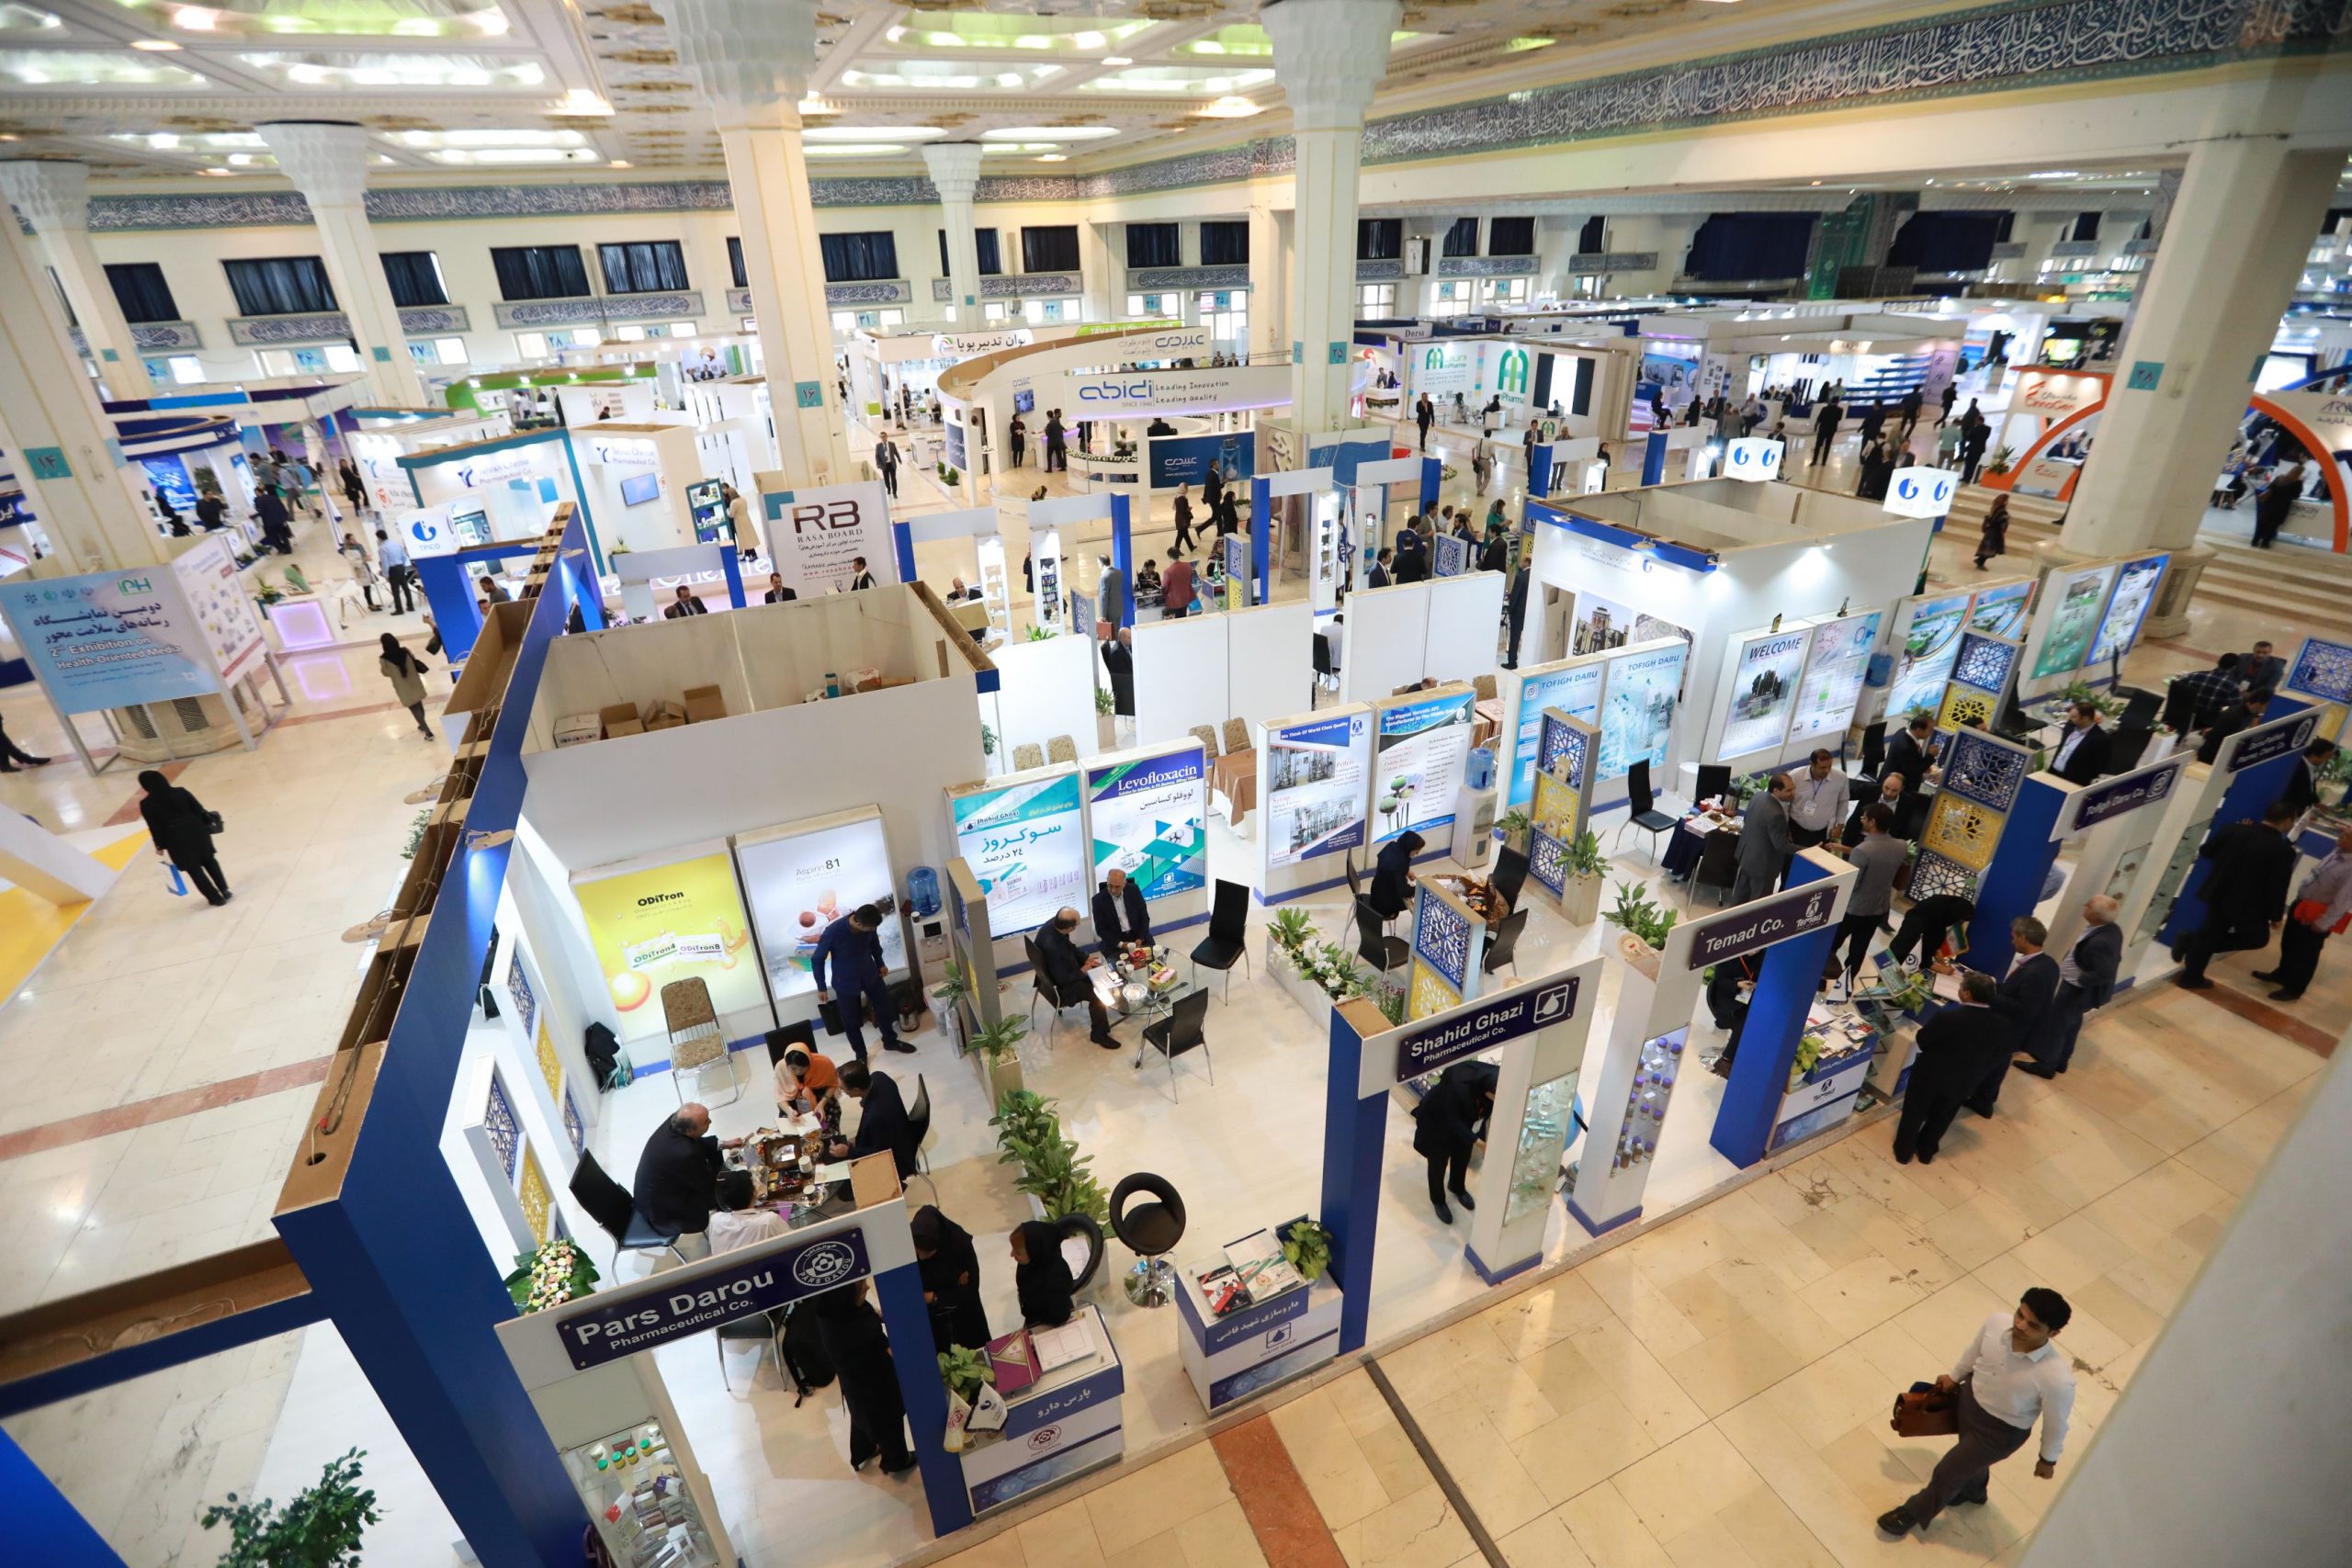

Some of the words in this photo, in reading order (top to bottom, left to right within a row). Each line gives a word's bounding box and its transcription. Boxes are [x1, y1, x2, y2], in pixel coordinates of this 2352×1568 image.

[1080, 379, 1153, 400] abidi
[1156, 383, 1186, 391] Leading
[1190, 380, 1229, 389] Innovation
[1156, 395, 1186, 404] Leading
[797, 534, 823, 543] RASA
[828, 529, 863, 539] BOARD
[69, 638, 133, 655] Exhibition
[135, 636, 151, 646] on
[146, 644, 183, 658] Media
[1749, 637, 1804, 660] WELCOME
[1628, 660, 1657, 671] TOFIGH
[1658, 655, 1679, 666] DARU
[1542, 675, 1573, 689] TOFIGH
[1575, 671, 1598, 682] DARU
[1118, 765, 1197, 791] Levofloxacin
[977, 814, 999, 825] Shahid
[825, 858, 841, 870] 81
[638, 891, 684, 907] ODiTron
[1706, 923, 1758, 953] Temad
[1760, 919, 1785, 934] Co.
[634, 942, 676, 964] ODiTron4
[680, 943, 721, 953] ODiTron8
[1411, 1021, 1471, 1056] Shahid
[1476, 1001, 1524, 1031] Ghazi
[1423, 1031, 1490, 1064] Pharmaceutical
[1492, 1026, 1506, 1036] Co.
[798, 1271, 821, 1284] PARS
[824, 1258, 852, 1282] DAROU
[575, 1308, 660, 1346] Pars
[669, 1270, 775, 1316] Darou
[610, 1306, 725, 1350] Pharmaceutical
[729, 1299, 753, 1312] Co.
[1063, 1388, 1091, 1407] پارس
[1037, 1401, 1060, 1418] دارو
